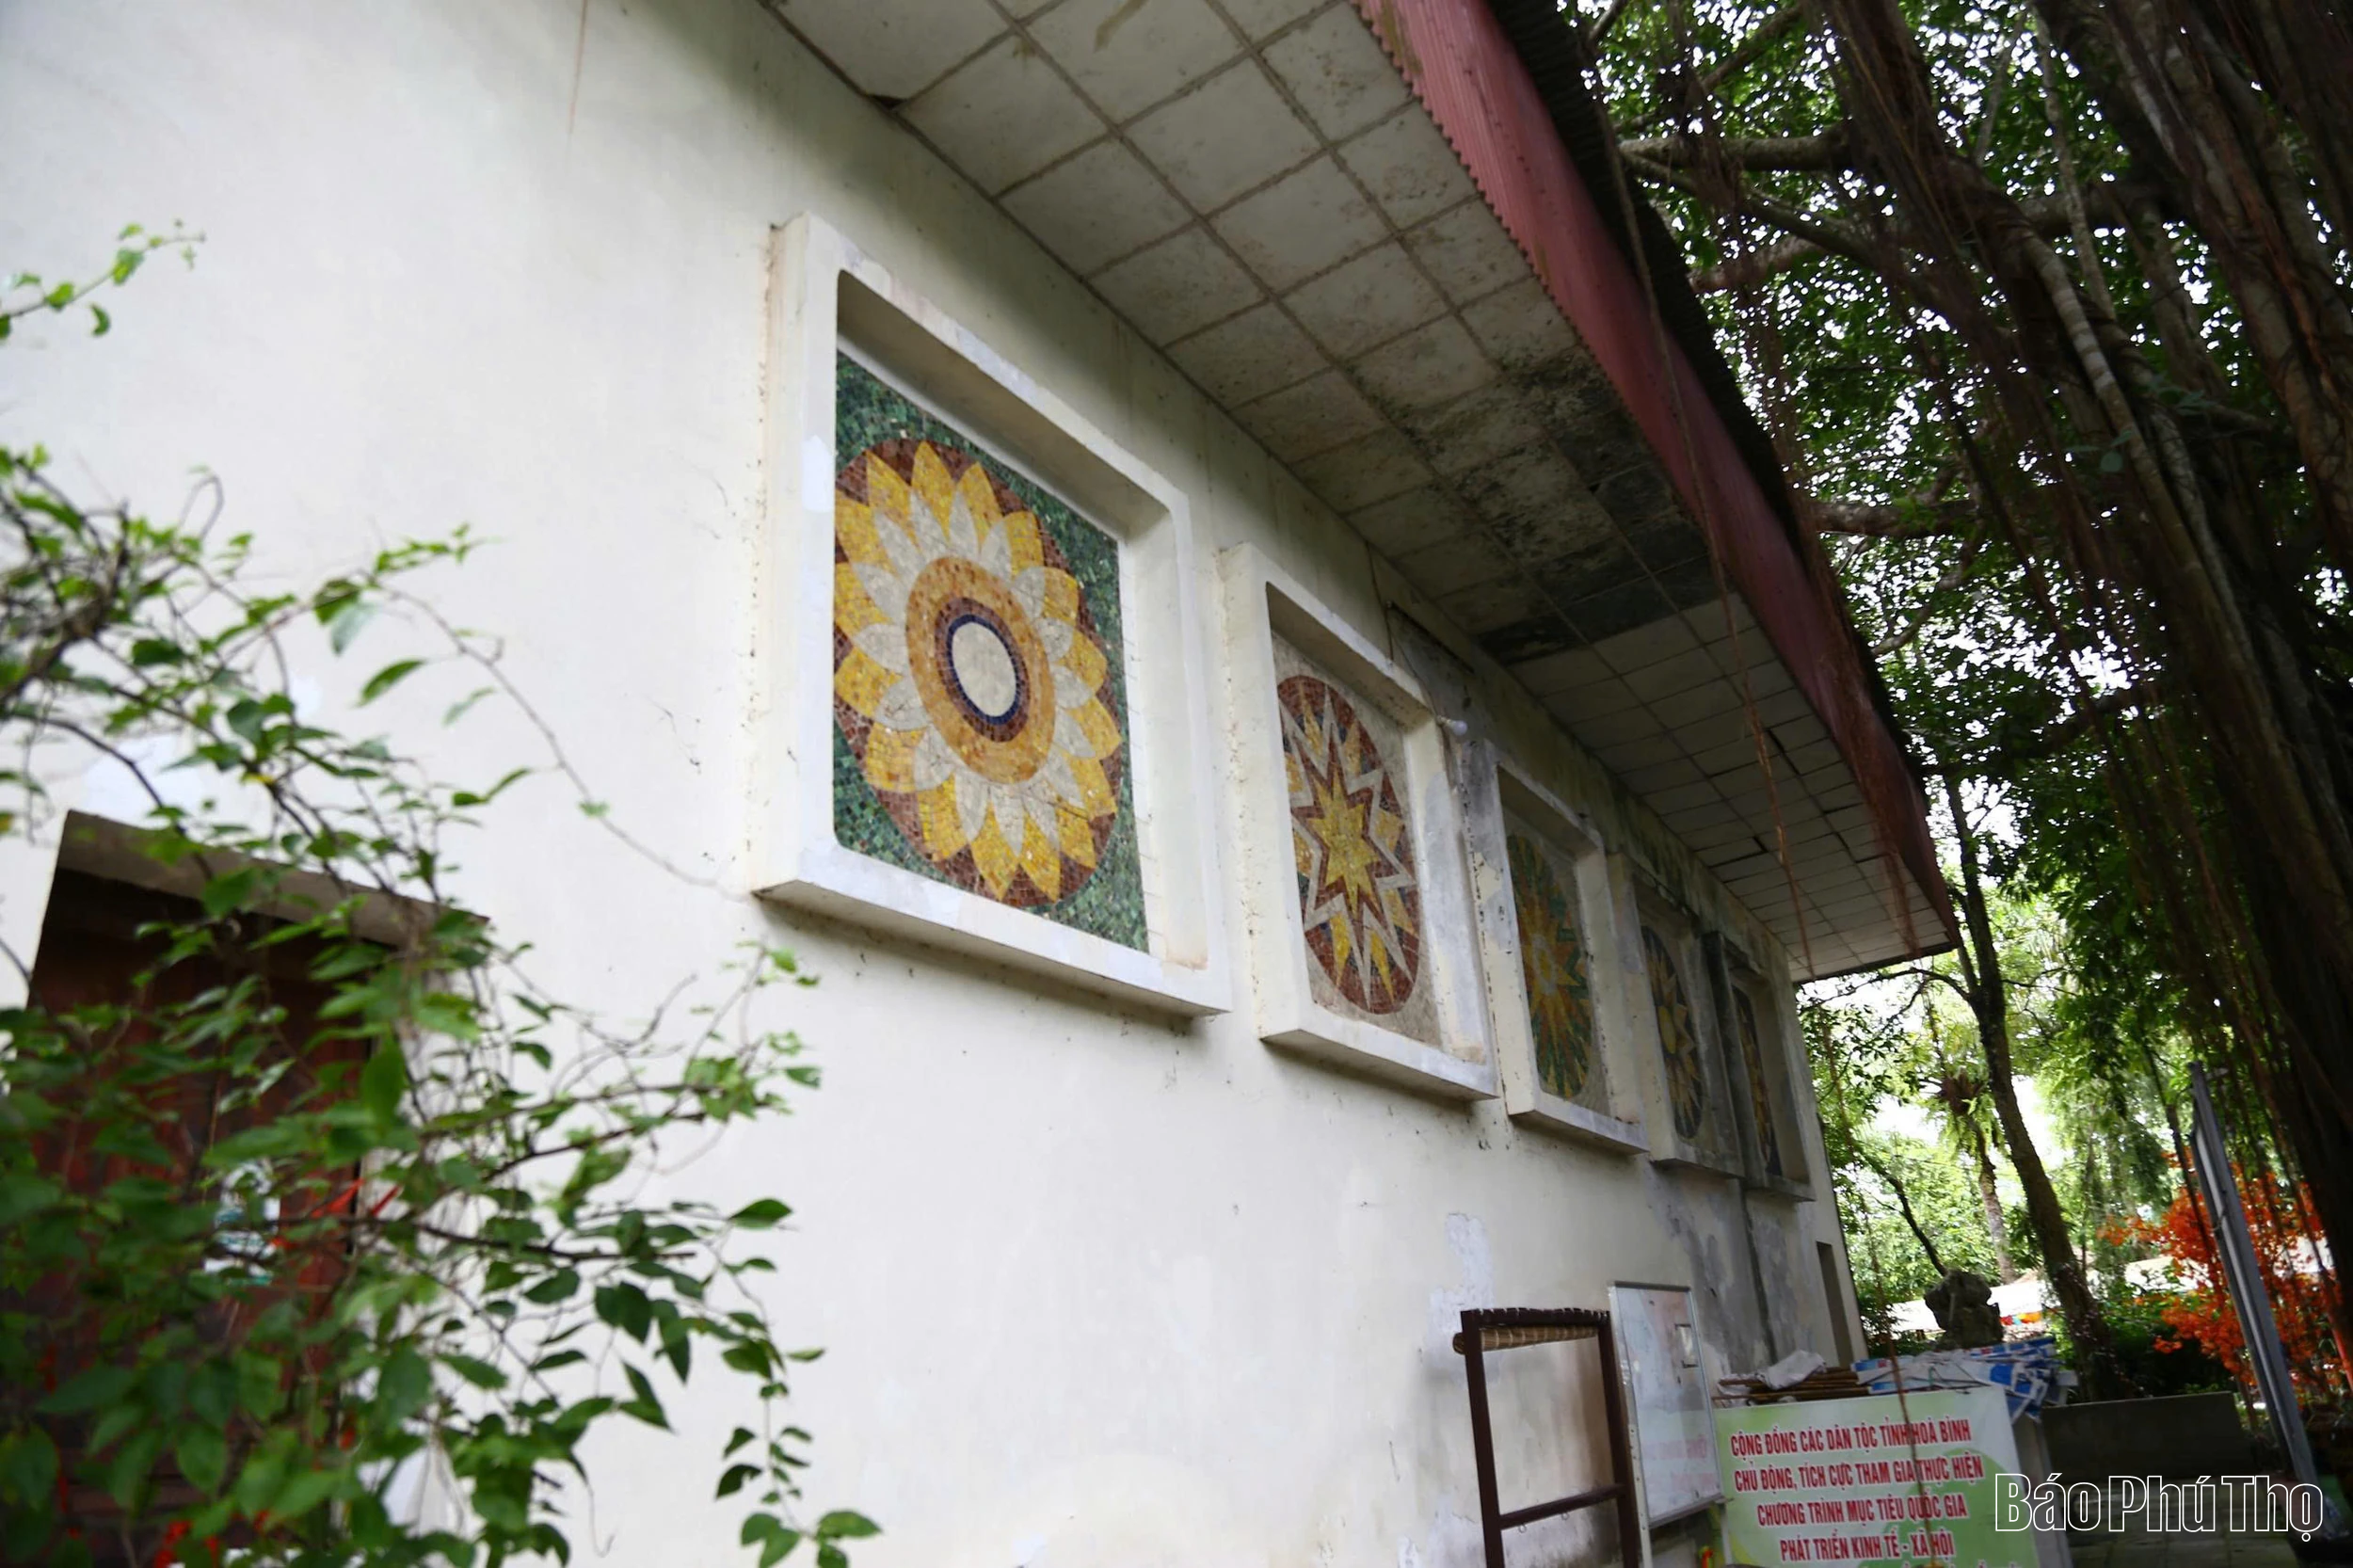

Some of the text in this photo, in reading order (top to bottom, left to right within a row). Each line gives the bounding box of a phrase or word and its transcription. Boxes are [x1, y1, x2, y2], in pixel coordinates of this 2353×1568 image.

[1800, 1426, 1824, 1451] CÁC
[1826, 1424, 1852, 1449] DÂN
[1853, 1422, 1878, 1452] TỘC
[1939, 1416, 1971, 1443] BÌNH
[1735, 1461, 1758, 1492] CHỦ
[1798, 1462, 1826, 1488] TÍCH
[1829, 1463, 1853, 1490] CỰC
[1855, 1462, 1891, 1484] THAM
[1893, 1460, 1915, 1482] GIA
[1951, 1451, 1983, 1483] HIỆN
[1757, 1502, 1805, 1526] CHƯƠNG
[1807, 1496, 1845, 1523] TRÌNH
[1846, 1499, 1875, 1527] MỤC
[1877, 1493, 1904, 1521] TIÊU
[1944, 1494, 1967, 1518] GIA
[1780, 1534, 1810, 1561] PHÁT
[1850, 1536, 1882, 1559] KINH
[1884, 1527, 1900, 1558] TẾ
[1911, 1528, 1929, 1557] XÃ
